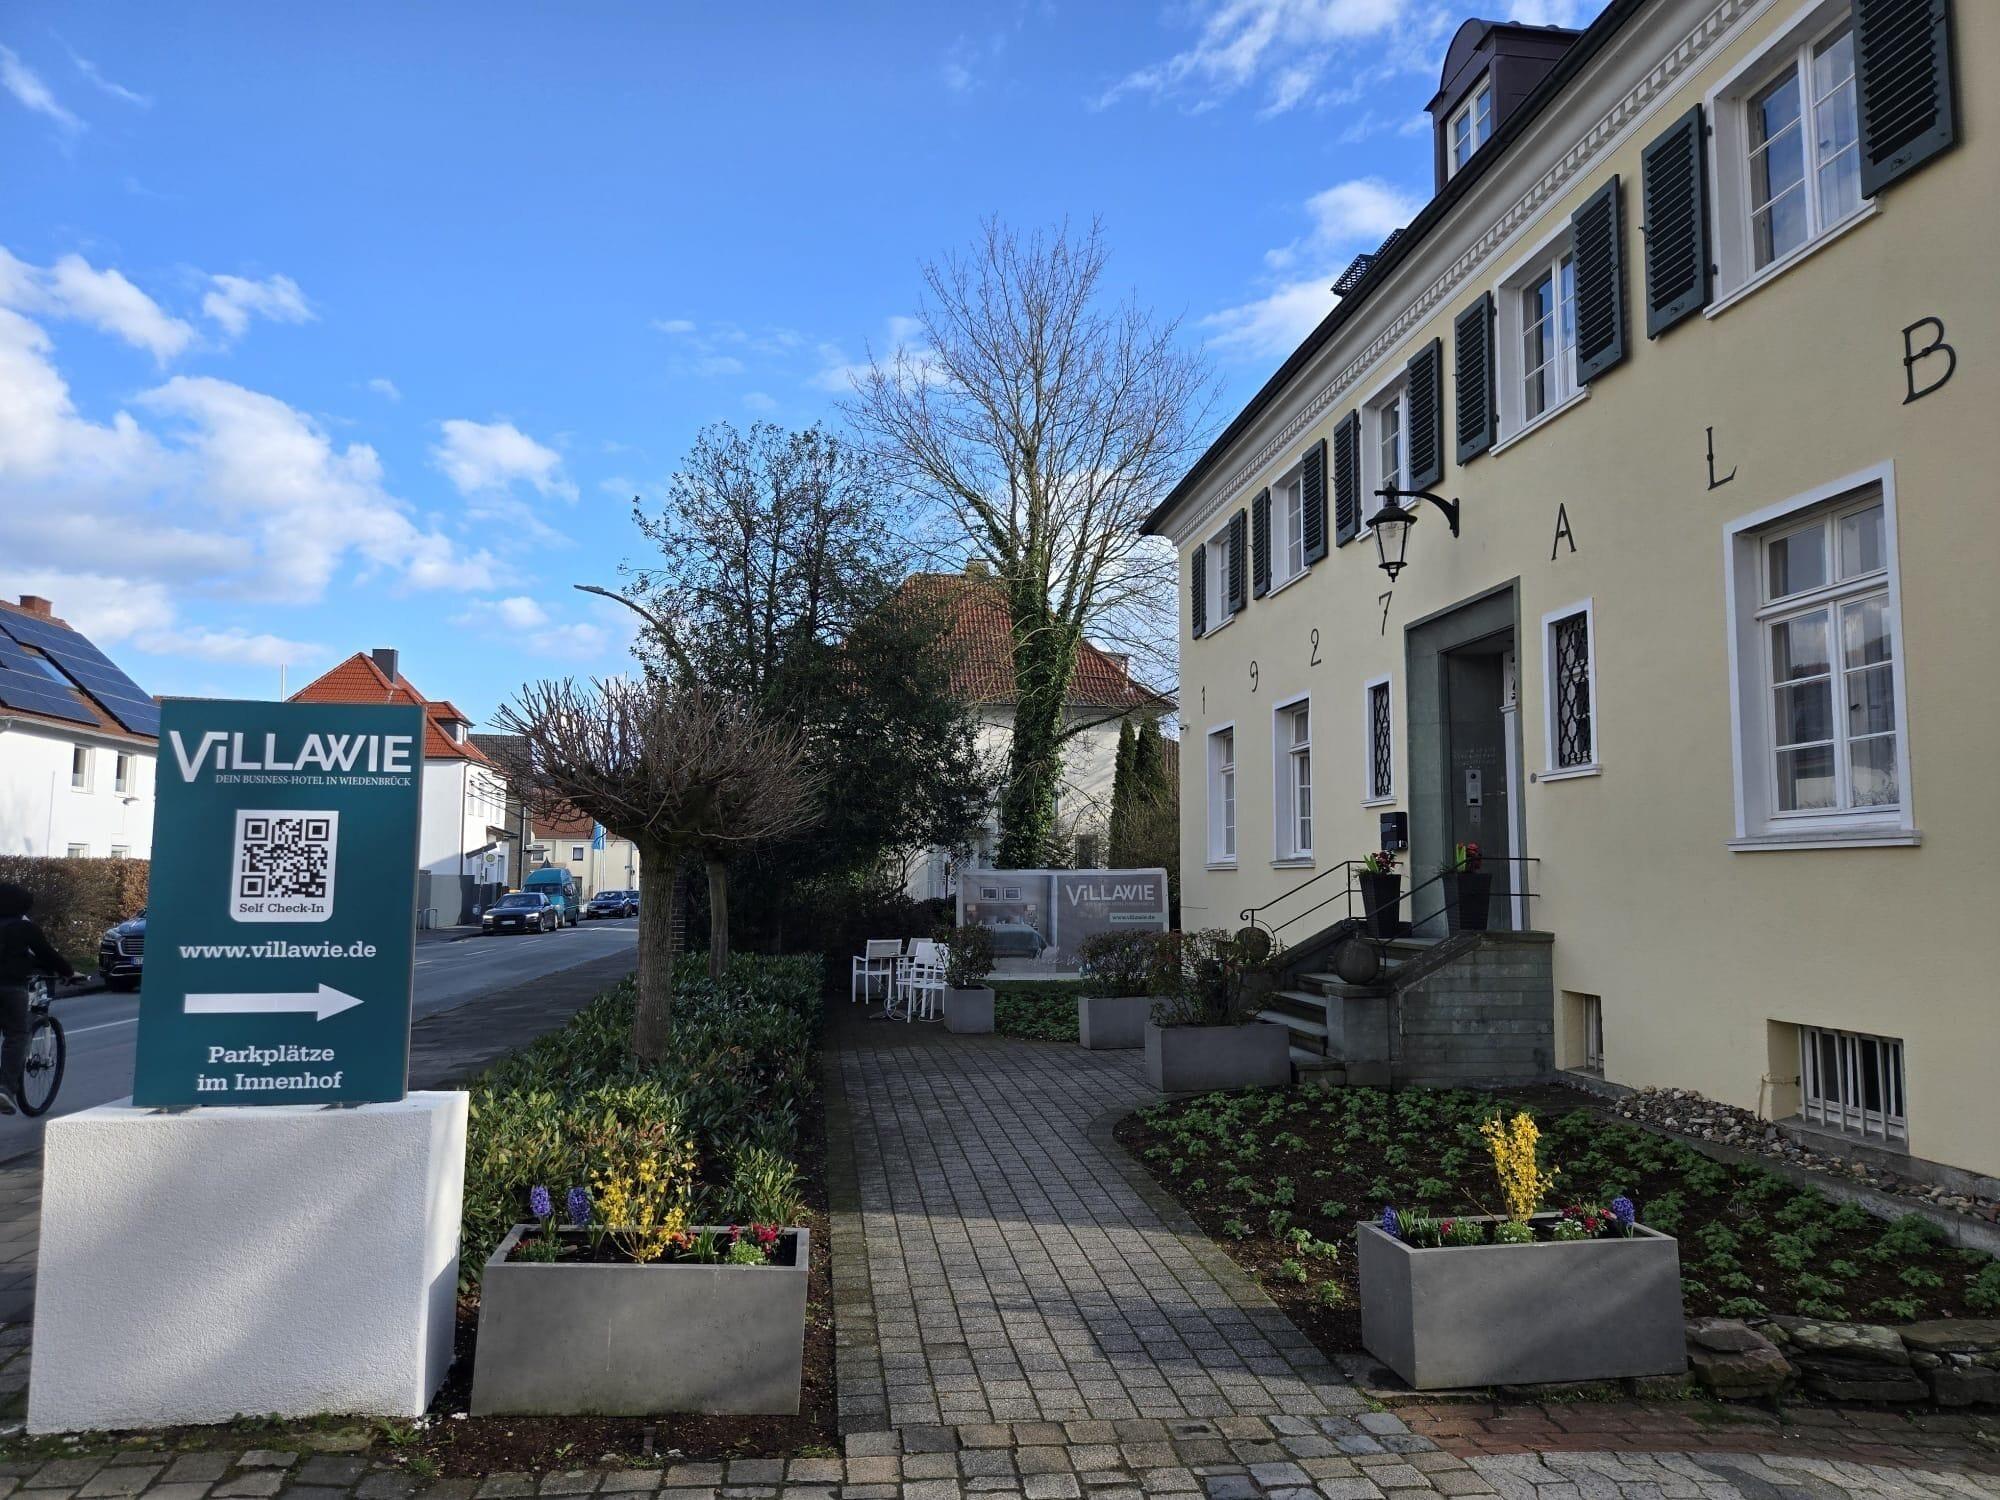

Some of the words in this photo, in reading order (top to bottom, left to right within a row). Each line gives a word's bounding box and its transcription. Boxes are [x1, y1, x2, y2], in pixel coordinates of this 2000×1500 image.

[215, 774, 241, 784] DEIN
[243, 775, 325, 785] BUSINESS-HOTEL
[326, 776, 338, 785] IN
[339, 775, 411, 786] WIEDENBRÜCK
[239, 903, 264, 913] Self
[267, 903, 325, 913] Check-In
[179, 941, 377, 959] www.villawie.de
[208, 1046, 335, 1066] Parkplätze
[197, 1074, 228, 1091] im
[234, 1072, 343, 1091] Innenhof
